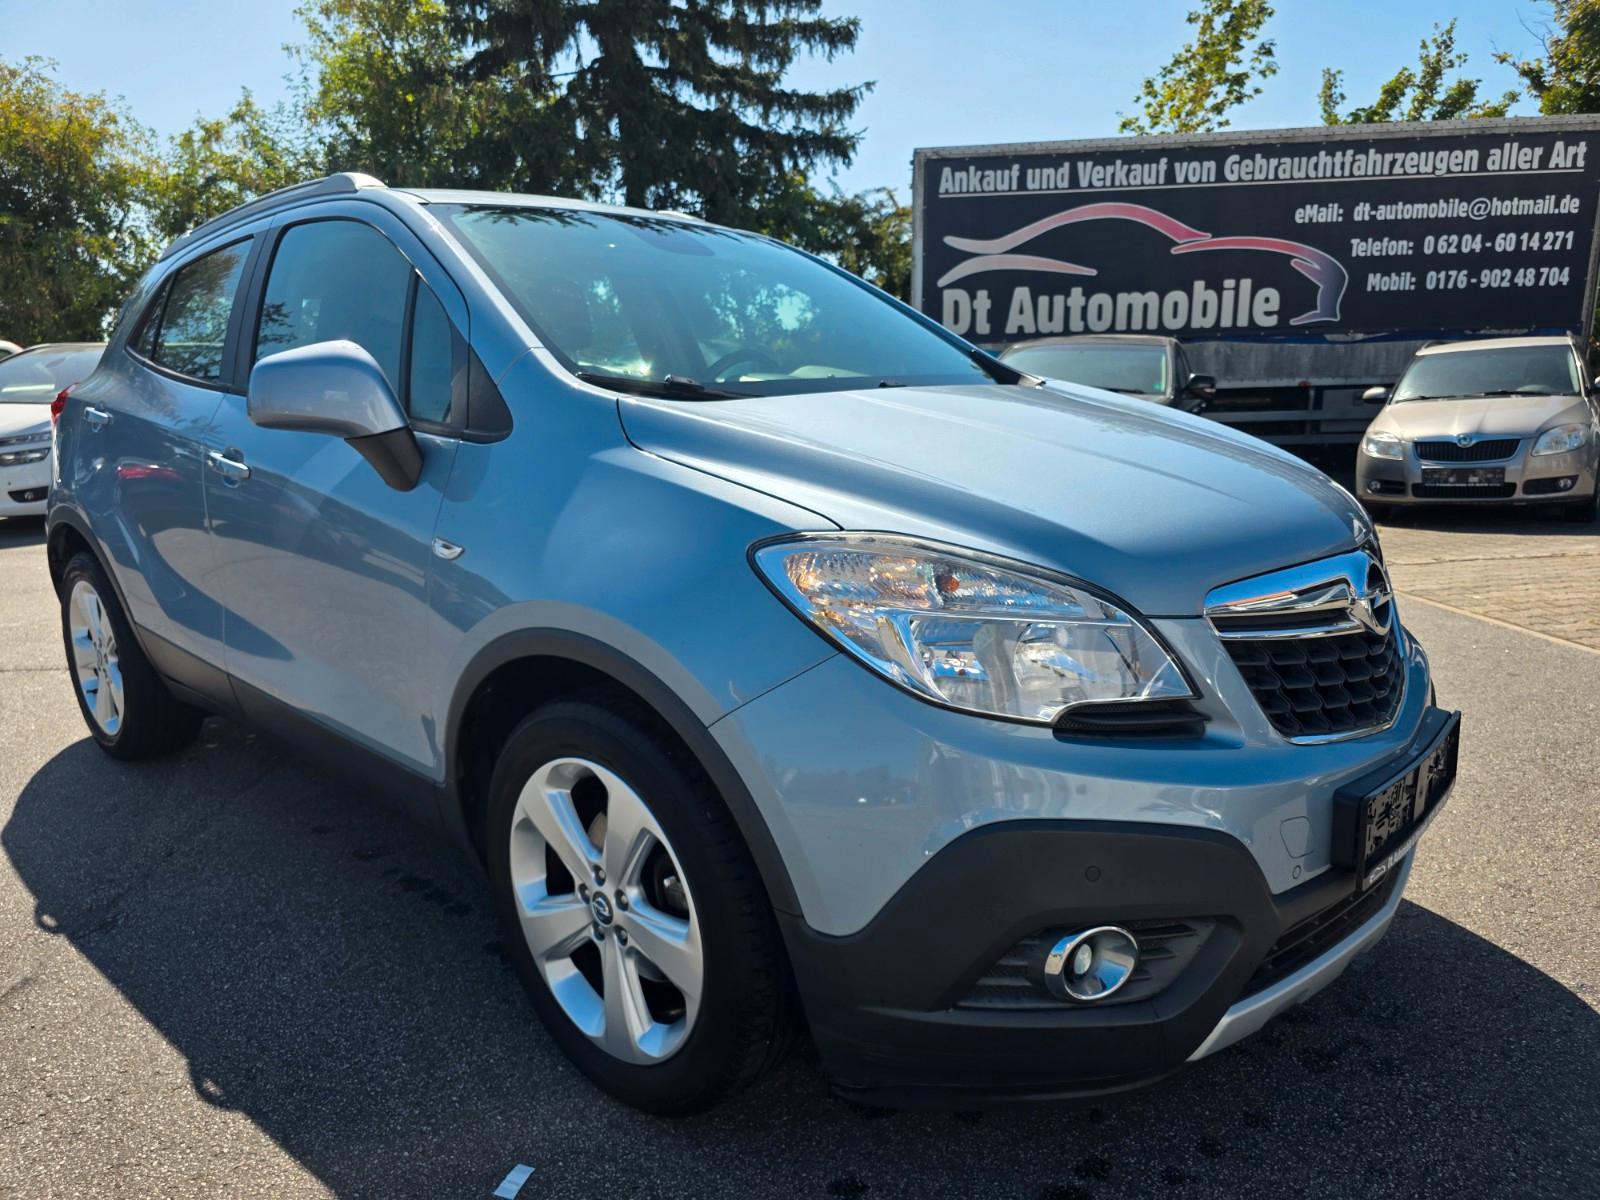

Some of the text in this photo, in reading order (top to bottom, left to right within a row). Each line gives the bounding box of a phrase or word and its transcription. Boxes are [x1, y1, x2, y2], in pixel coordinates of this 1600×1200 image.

[939, 140, 1587, 193] Ankauf und Verkauf von Gebrauchtfahrzeugen aller Art
[1295, 195, 1580, 224] eMail: dt-automobile@hotmail.de
[1350, 237, 1414, 257] Telefon:
[1367, 271, 1416, 291] Mobil:
[942, 278, 1280, 335] Dt Automobile
